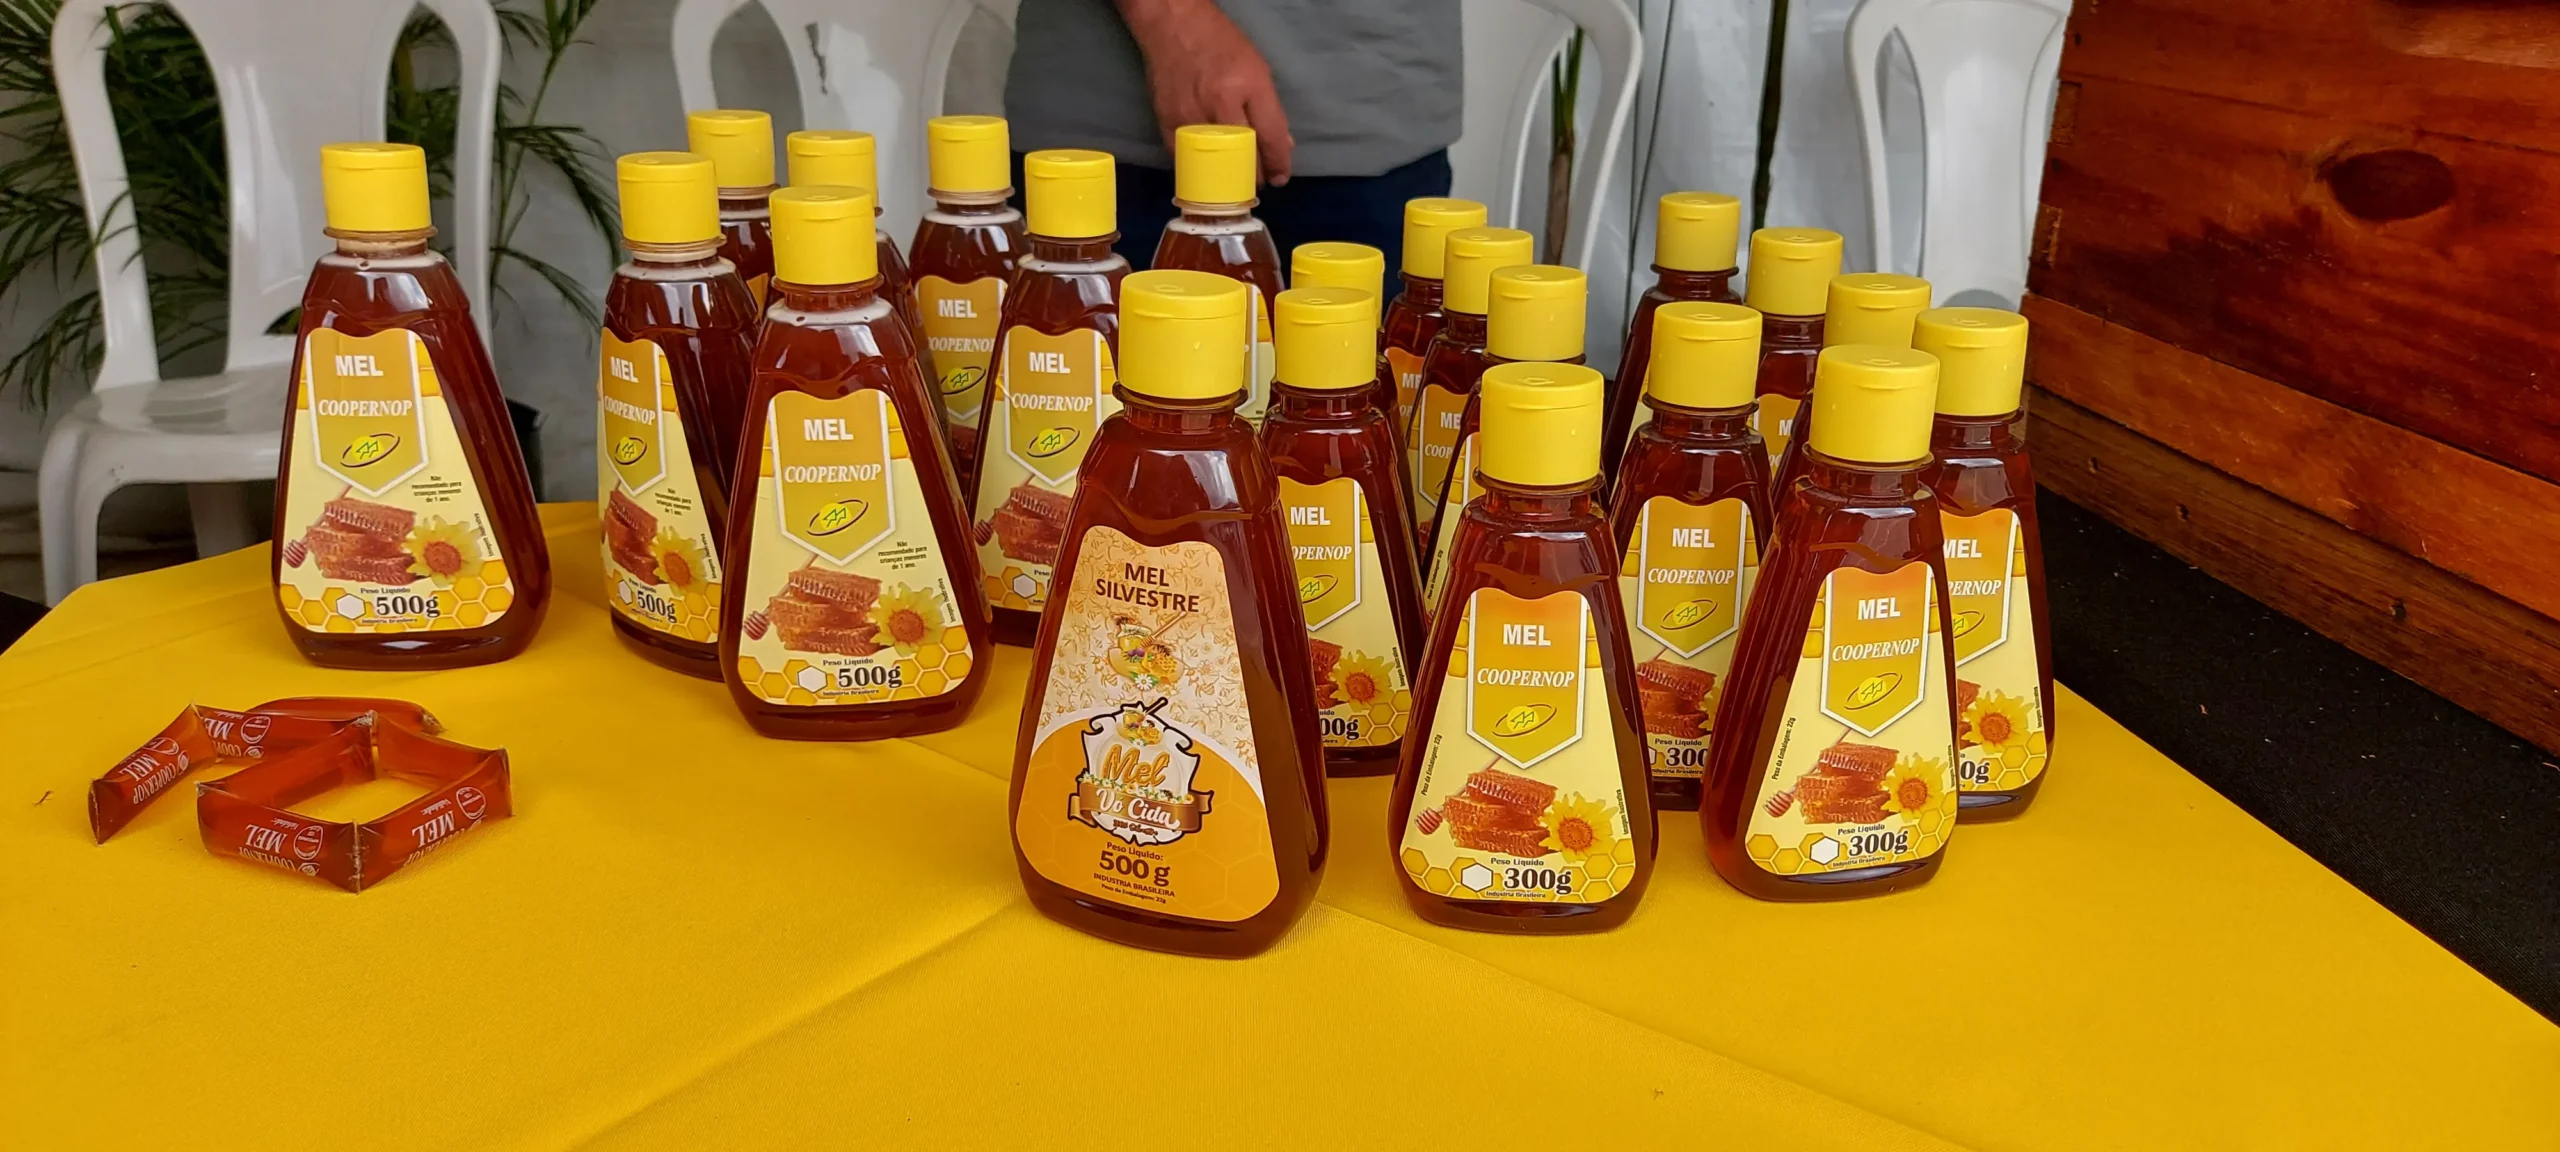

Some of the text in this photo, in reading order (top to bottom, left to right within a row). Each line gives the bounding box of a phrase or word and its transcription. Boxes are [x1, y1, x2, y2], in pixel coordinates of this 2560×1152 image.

[938, 299, 977, 318] MEL
[928, 336, 995, 352] OOPERNO
[335, 355, 384, 377] MEL
[610, 356, 639, 384] MEL
[1029, 351, 1071, 374] MEL
[318, 398, 413, 417] COOPERNOP
[604, 395, 656, 426] COOPERNOP
[1012, 392, 1093, 412] COOPERNOP
[803, 418, 854, 441] MEL
[1440, 411, 1463, 430] ME
[784, 463, 882, 484] COOPERNOP
[1290, 506, 1331, 526] MEL
[1672, 527, 1715, 548] MEL
[1943, 538, 1982, 559] MEL
[1292, 545, 1353, 560] OPERNOP
[1124, 562, 1170, 587] MEL
[1647, 567, 1735, 585] COOPERNOP
[1095, 578, 1200, 613] SILVESTRE
[1948, 579, 2002, 596] PERNOP
[376, 595, 441, 619] 500g
[637, 590, 677, 624] 500g
[1857, 596, 1901, 621] MEL
[1502, 623, 1551, 647] MEL
[1832, 638, 1920, 662] COOPERNOP
[838, 665, 903, 688] 500g
[1476, 667, 1575, 688] COOPERNOP
[203, 717, 235, 741] ME
[1320, 717, 1360, 740] 00g
[1666, 747, 1709, 767] 300
[1771, 717, 1796, 781] Peso da Embalagem: 22g
[118, 753, 161, 782] MEL
[1102, 743, 1171, 787] Mel
[1959, 760, 1990, 784] 0g
[133, 762, 177, 805] COOPERNOP
[1421, 783, 1429, 797] Peso
[1096, 788, 1124, 813] Vó
[1127, 798, 1180, 830] Cida
[245, 824, 288, 855] MEL
[411, 810, 455, 848] MEL
[1837, 827, 1856, 836] Peso
[1106, 841, 1127, 853] Peso
[1848, 830, 1909, 857] 300g
[1099, 850, 1171, 887] 500 g
[1490, 857, 1511, 865] Peso
[1133, 882, 1175, 897] BRASILEIRA
[1503, 867, 1572, 895] 300g
[1515, 891, 1546, 899] Brasileira
